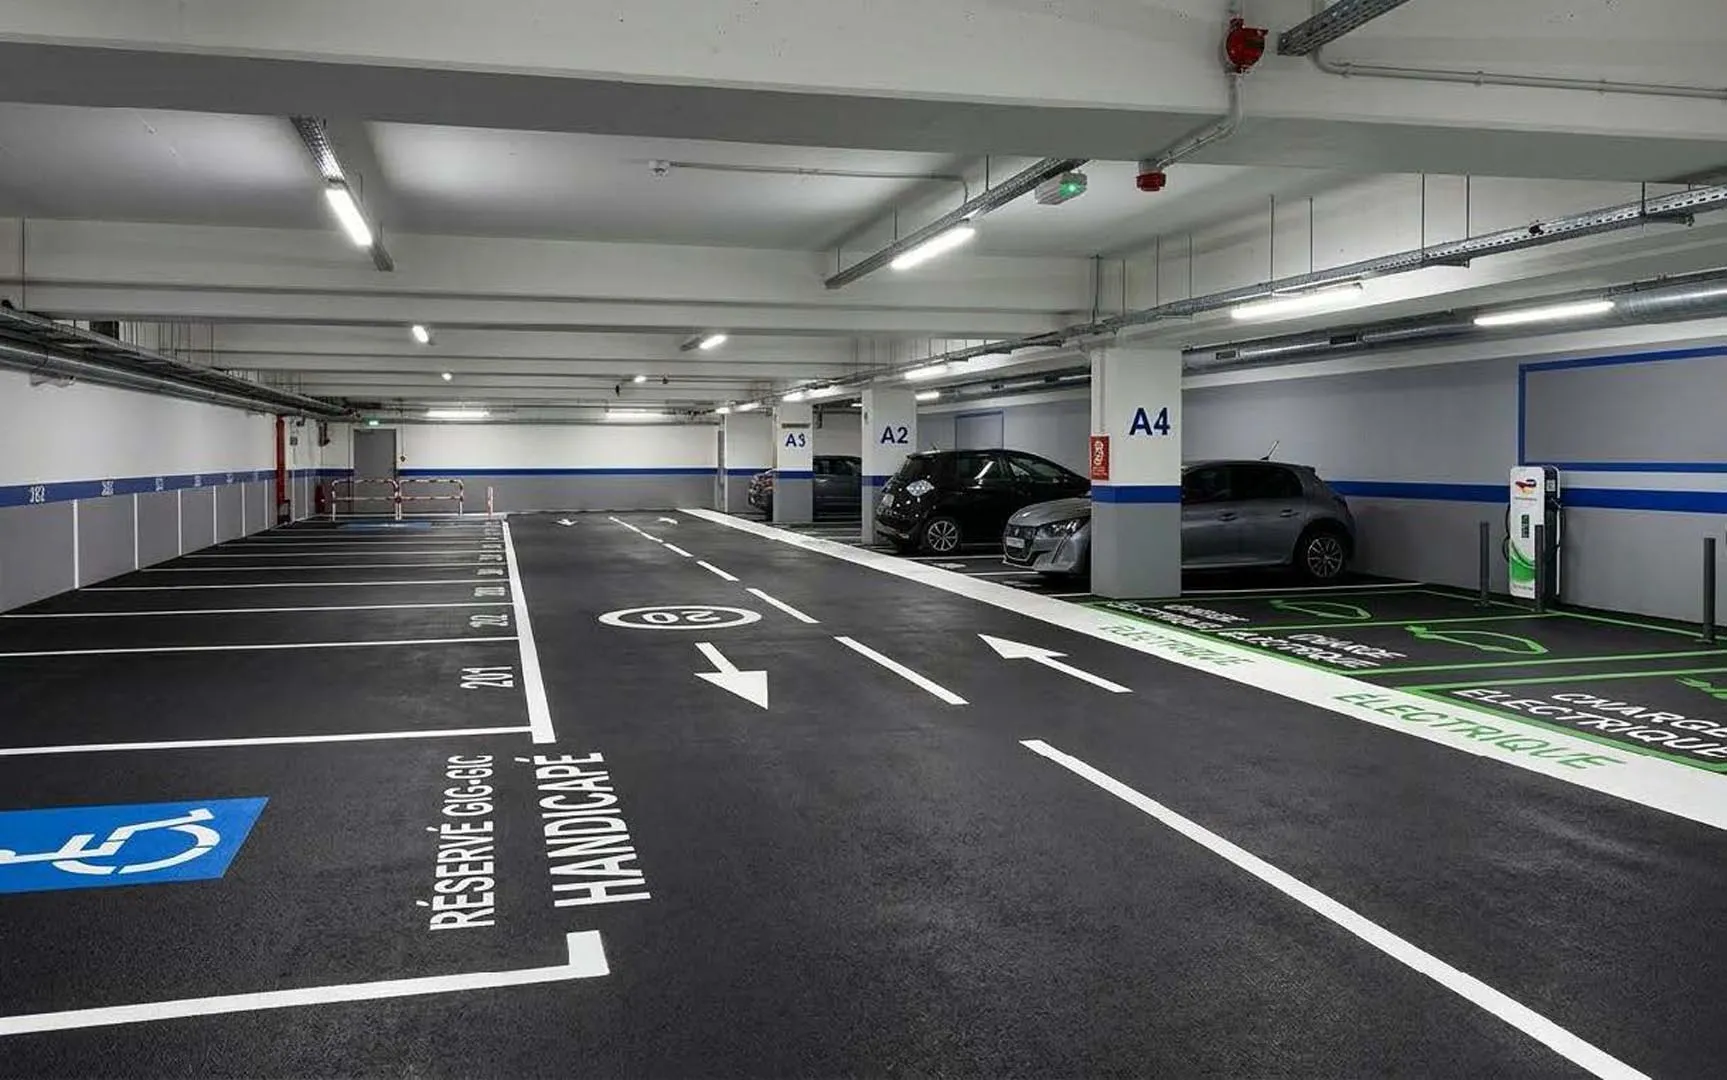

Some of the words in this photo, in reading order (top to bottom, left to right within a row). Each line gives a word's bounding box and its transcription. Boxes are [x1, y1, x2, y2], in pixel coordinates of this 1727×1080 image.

[880, 426, 908, 444] A2
[1129, 407, 1171, 436] A4
[642, 610, 721, 624] 20
[460, 666, 514, 689] 201
[1333, 693, 1627, 769] ELECTRIQUE
[1453, 688, 1727, 758] ELECTRIQUE
[1552, 693, 1727, 738] CHARGE
[514, 752, 651, 907] HANDICAPÉ
[416, 821, 495, 931] RÉSERVÉ
